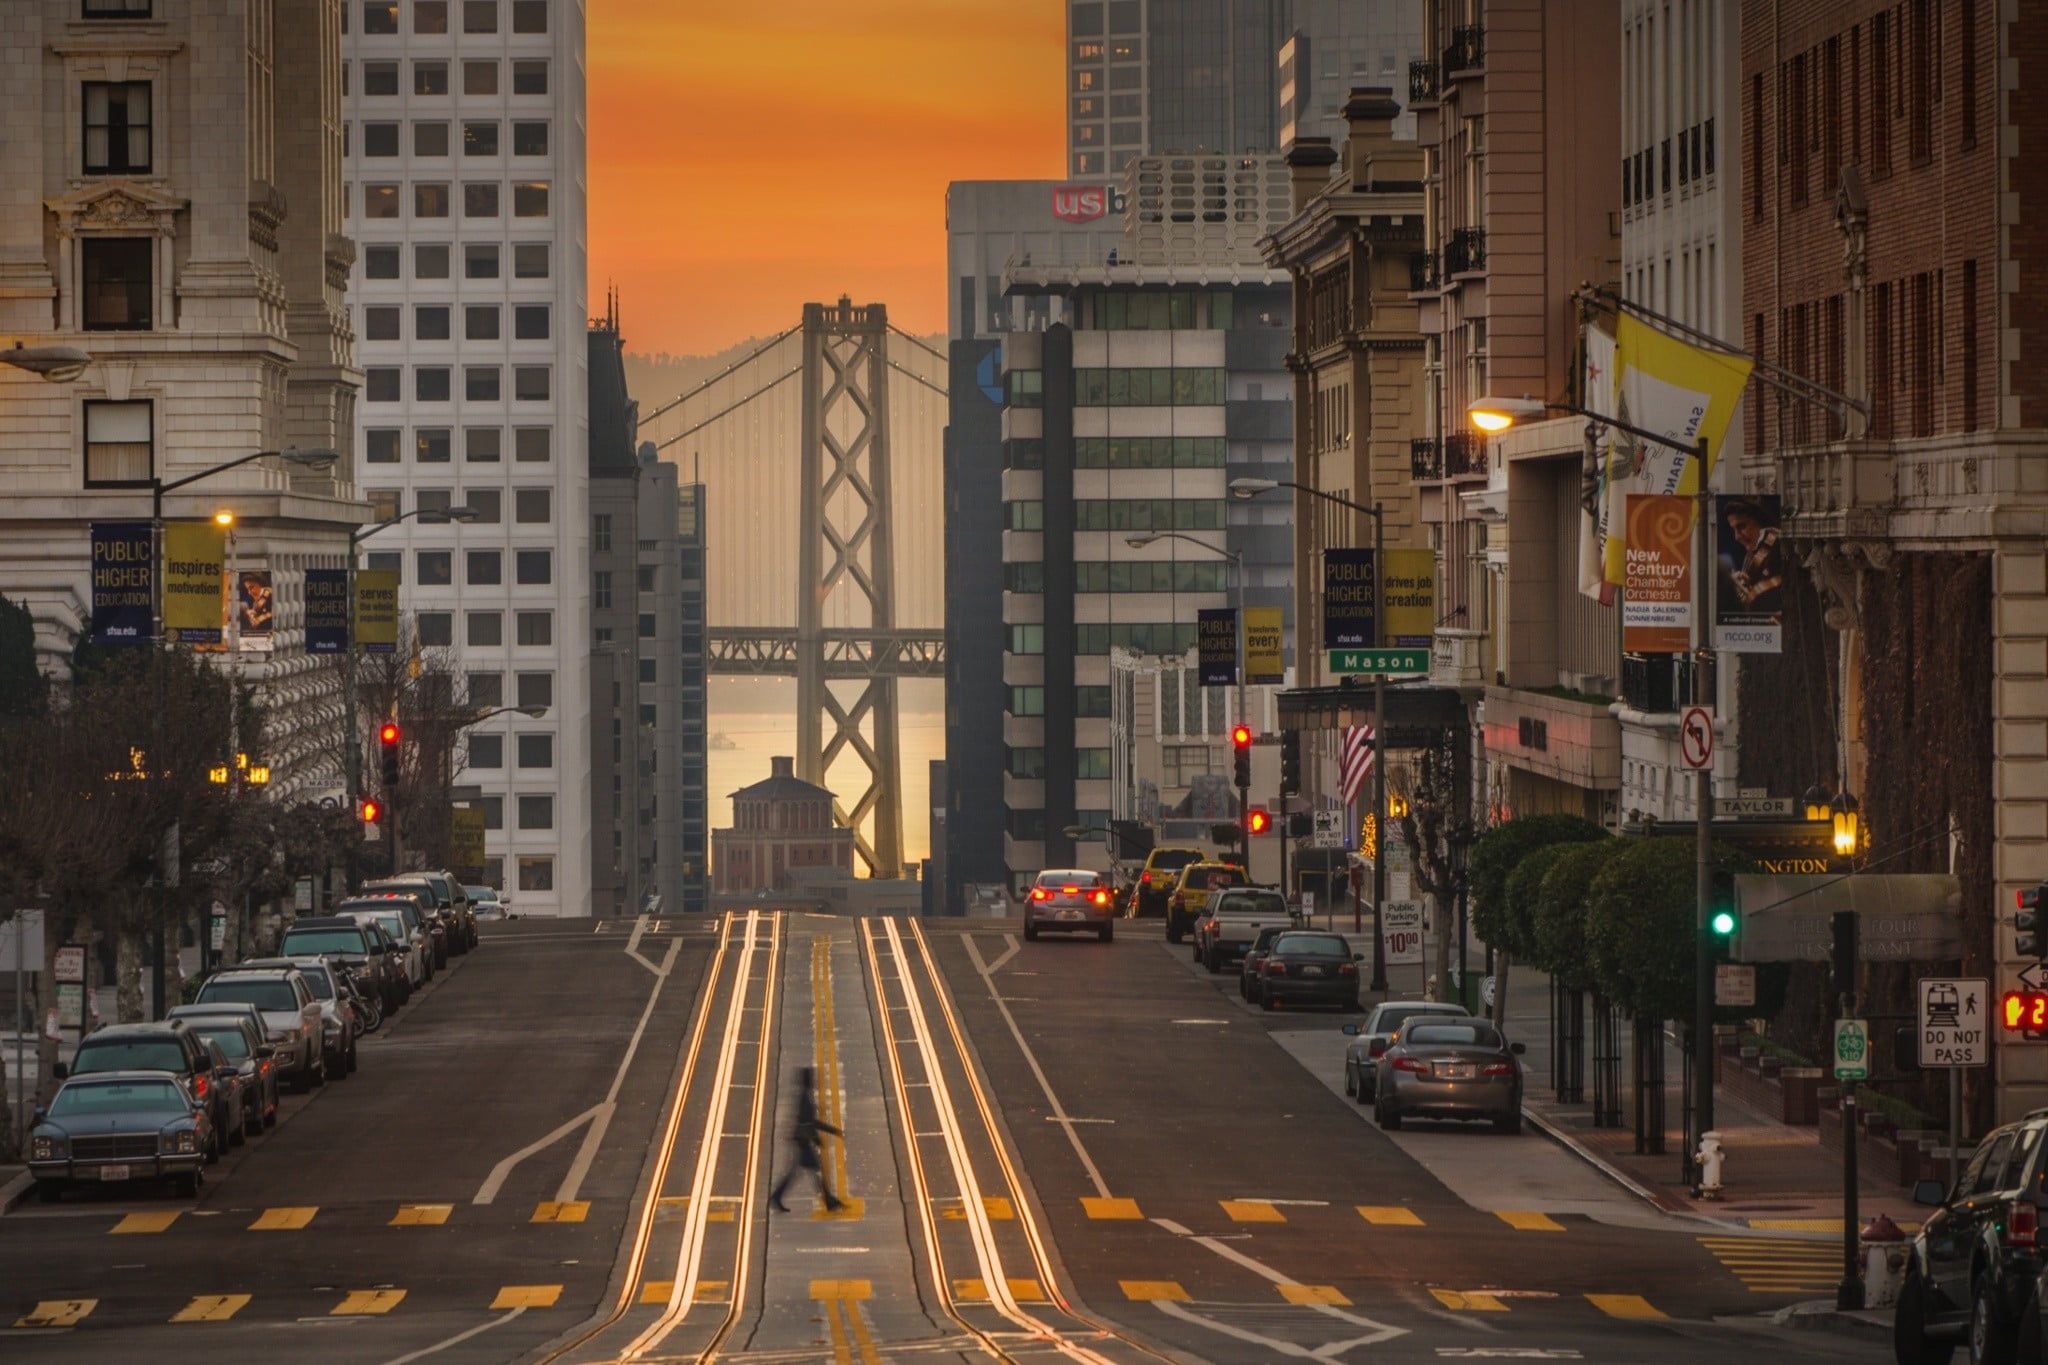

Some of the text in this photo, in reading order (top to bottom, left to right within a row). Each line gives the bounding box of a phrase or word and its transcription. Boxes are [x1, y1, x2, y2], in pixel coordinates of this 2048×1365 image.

[94, 541, 150, 561] PUBLIC
[1626, 549, 1661, 562] New
[168, 558, 220, 577] inspires
[1326, 563, 1373, 581] PUBLIC
[1626, 562, 1685, 580] Century
[95, 567, 150, 588] HIGHER
[1384, 576, 1433, 591] drives job
[1625, 576, 1679, 589] Chamber
[167, 582, 220, 595] motivation
[307, 581, 346, 597] PUBLIC
[360, 589, 393, 600] serves
[1326, 585, 1374, 602] HIGHER
[1625, 588, 1682, 601] Orchestra
[95, 592, 150, 608] EDUCATION
[1384, 592, 1433, 608] creation
[307, 602, 346, 616] HIGHER
[1326, 606, 1375, 618] EDUCATION
[106, 626, 137, 636] sfsu.edu
[1201, 620, 1235, 634] PUBLIC
[1201, 637, 1235, 651] HIGHER
[1247, 635, 1280, 650] every
[1724, 631, 1773, 645] ncco.org
[1344, 655, 1415, 669] Mason
[1722, 801, 1785, 813] TAYLOR
[1387, 903, 1416, 912] Public
[1385, 912, 1419, 921] Parking
[1926, 1030, 1981, 1044] DO NOT
[1935, 1048, 1973, 1061] PASS
